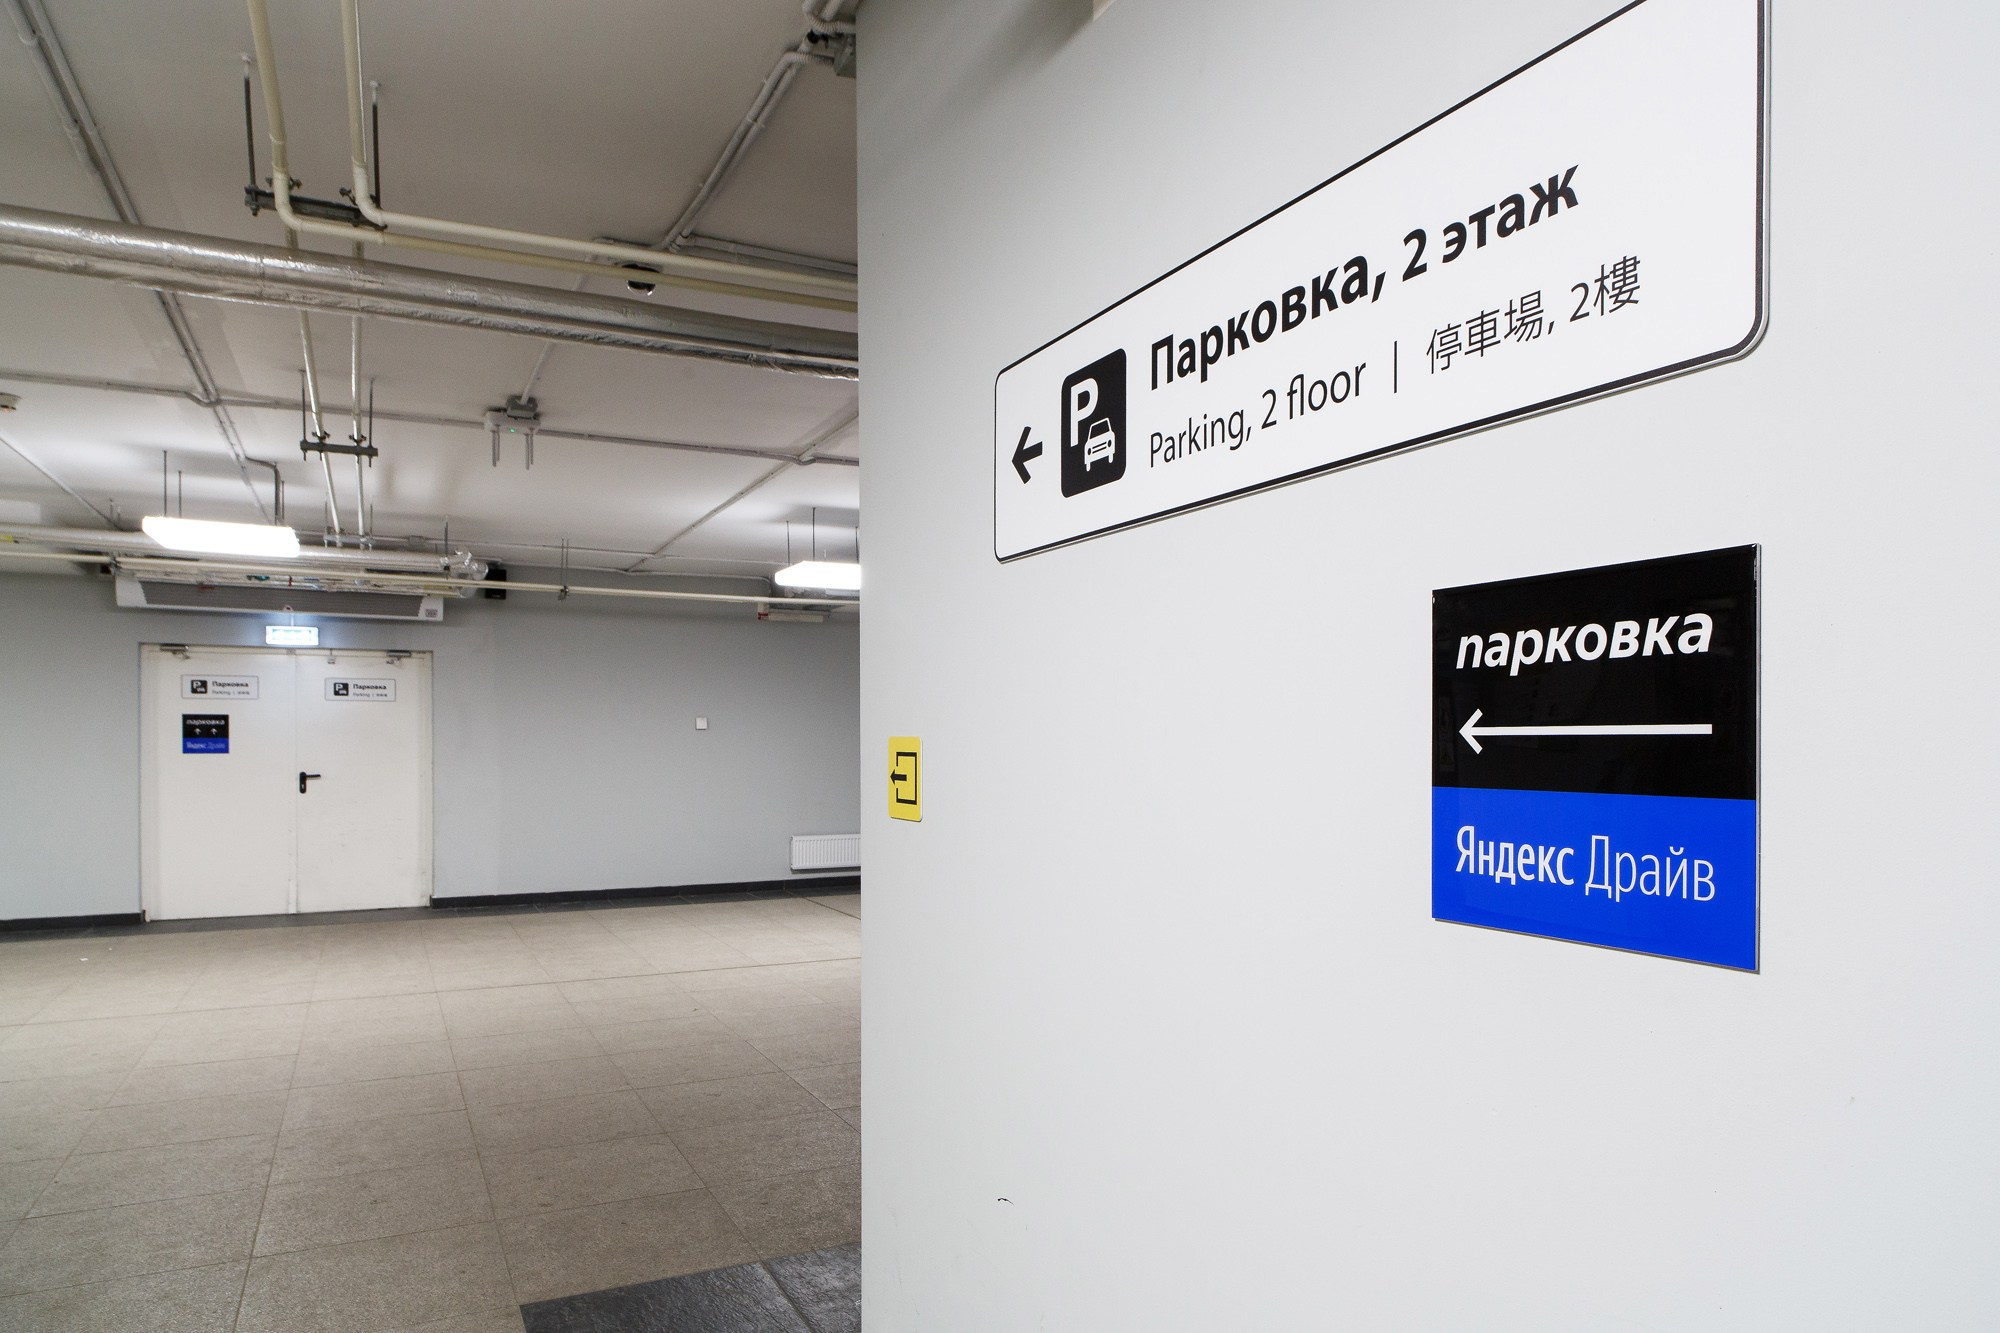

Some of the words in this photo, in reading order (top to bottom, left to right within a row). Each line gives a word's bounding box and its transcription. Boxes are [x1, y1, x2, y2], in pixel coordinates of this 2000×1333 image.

[1151, 255, 1386, 391] Парковка,
[1402, 228, 1428, 282] 2
[1442, 164, 1579, 264] этаж
[1150, 408, 1253, 468] Parking,
[1261, 388, 1277, 430] 2
[1286, 361, 1367, 420] floor
[1456, 612, 1713, 677] парковка
[212, 681, 249, 689] Парковка
[353, 683, 388, 691] Парковка
[1455, 825, 1575, 886] Яндекс
[1584, 834, 1716, 903] Драйв
